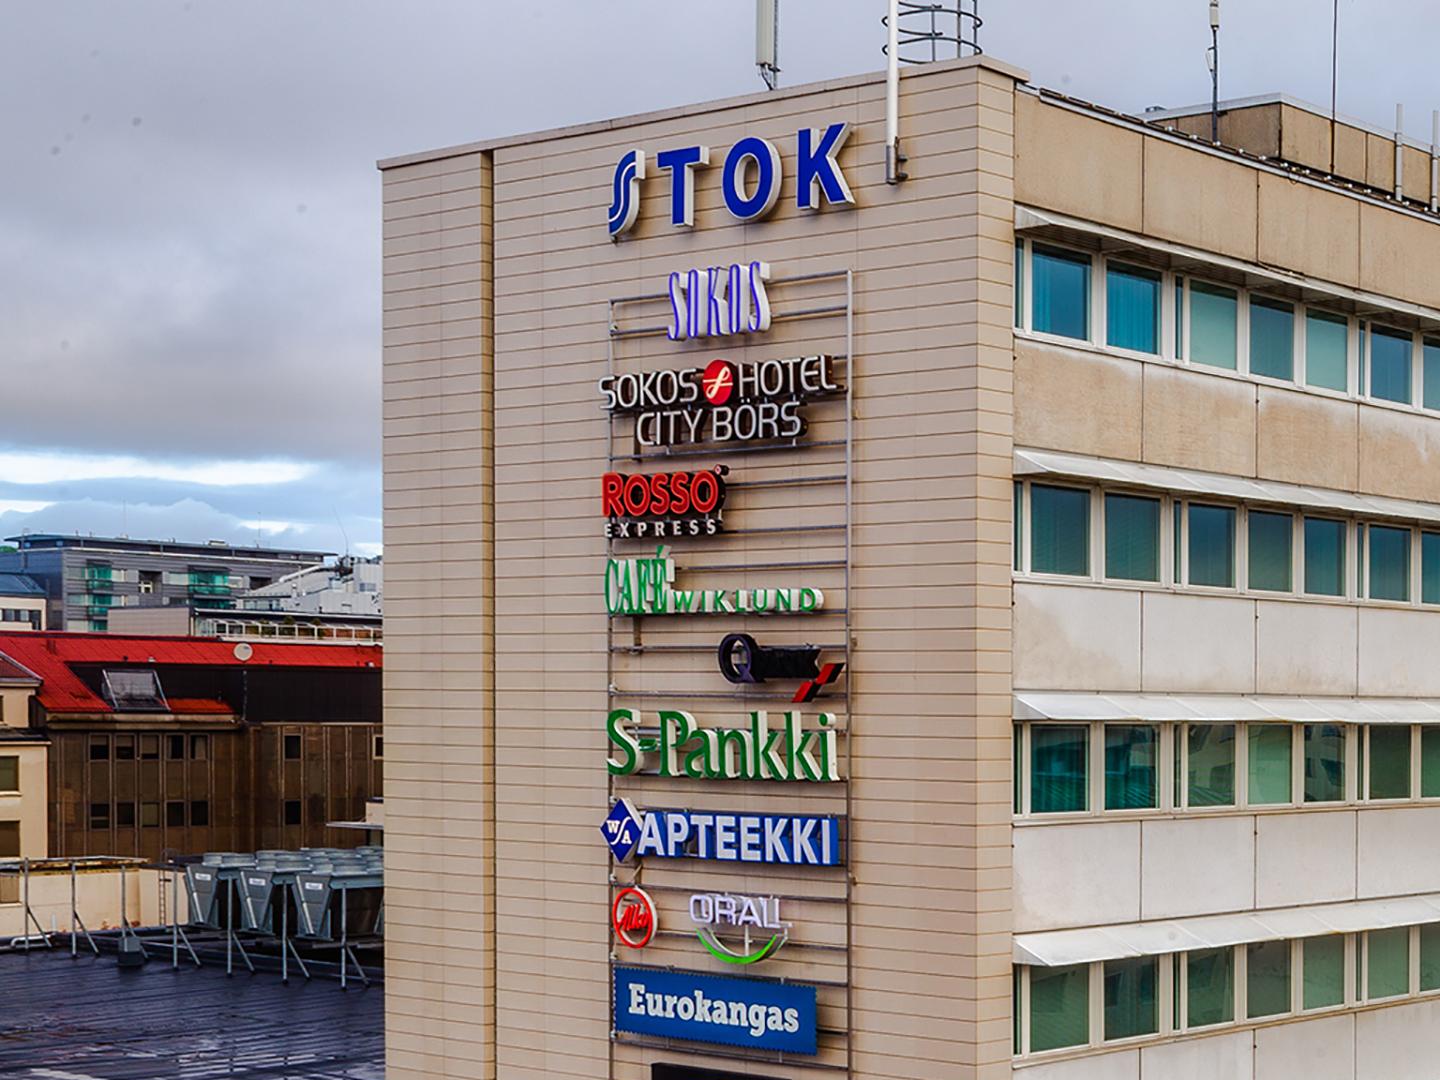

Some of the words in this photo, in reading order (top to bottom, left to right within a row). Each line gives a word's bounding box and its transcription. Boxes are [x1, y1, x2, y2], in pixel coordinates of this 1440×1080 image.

[600, 368, 698, 409] SOKOS
[738, 355, 837, 399] HOTEL
[636, 408, 702, 446] CITY
[712, 398, 802, 441] BÖRS
[602, 469, 720, 517] ROSSO
[604, 519, 718, 538] EXPRESS
[605, 545, 675, 614] CAFÉ
[673, 587, 824, 613] WIKLUND
[606, 709, 842, 781] S-Pankki
[637, 812, 834, 864] APTEEKKI
[628, 983, 800, 1037] Eurokangas
